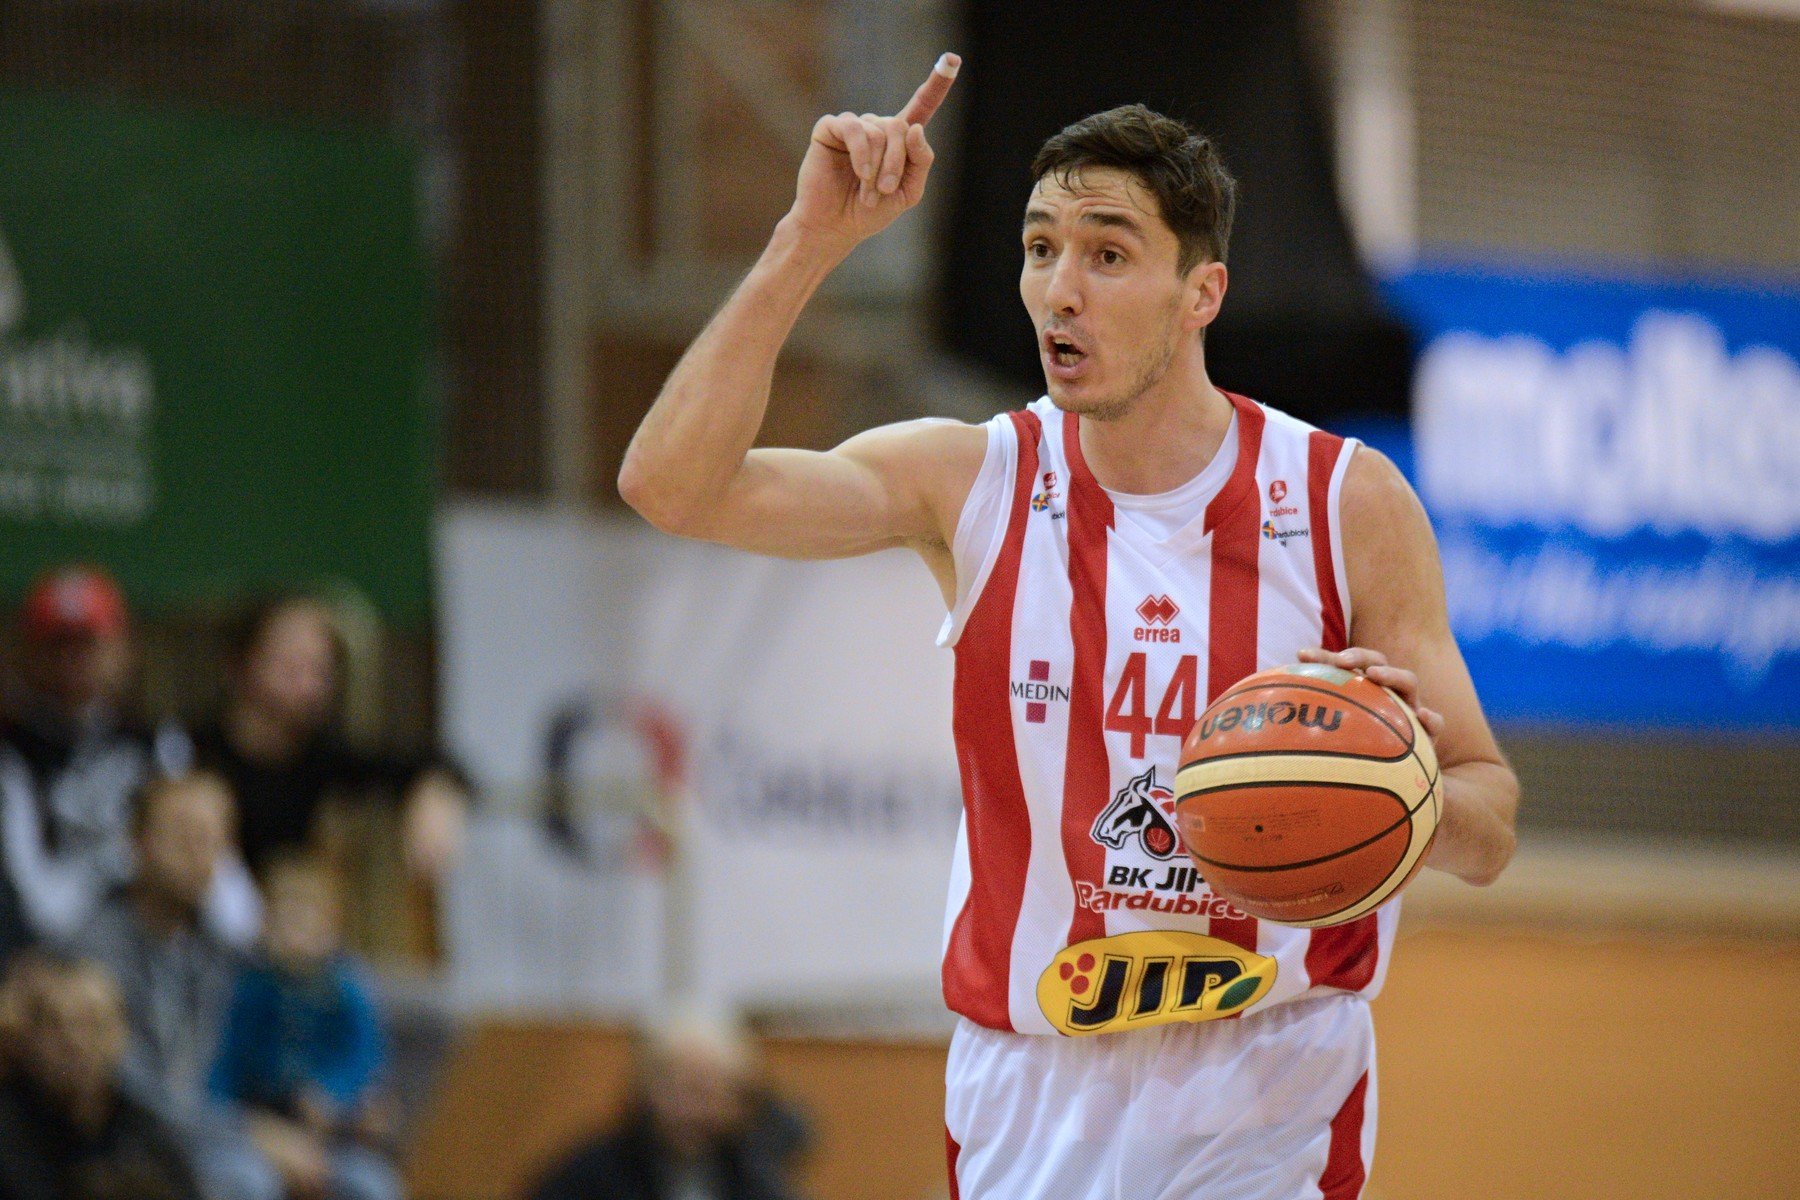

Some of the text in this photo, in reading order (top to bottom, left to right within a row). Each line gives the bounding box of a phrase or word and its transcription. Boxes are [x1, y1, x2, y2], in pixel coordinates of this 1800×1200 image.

[1133, 627, 1181, 643] errea
[1011, 681, 1070, 702] MEDIN
[1104, 652, 1200, 759] 44
[1200, 701, 1343, 741] molten
[1107, 865, 1153, 888] BK
[1066, 953, 1248, 1031] JIP
